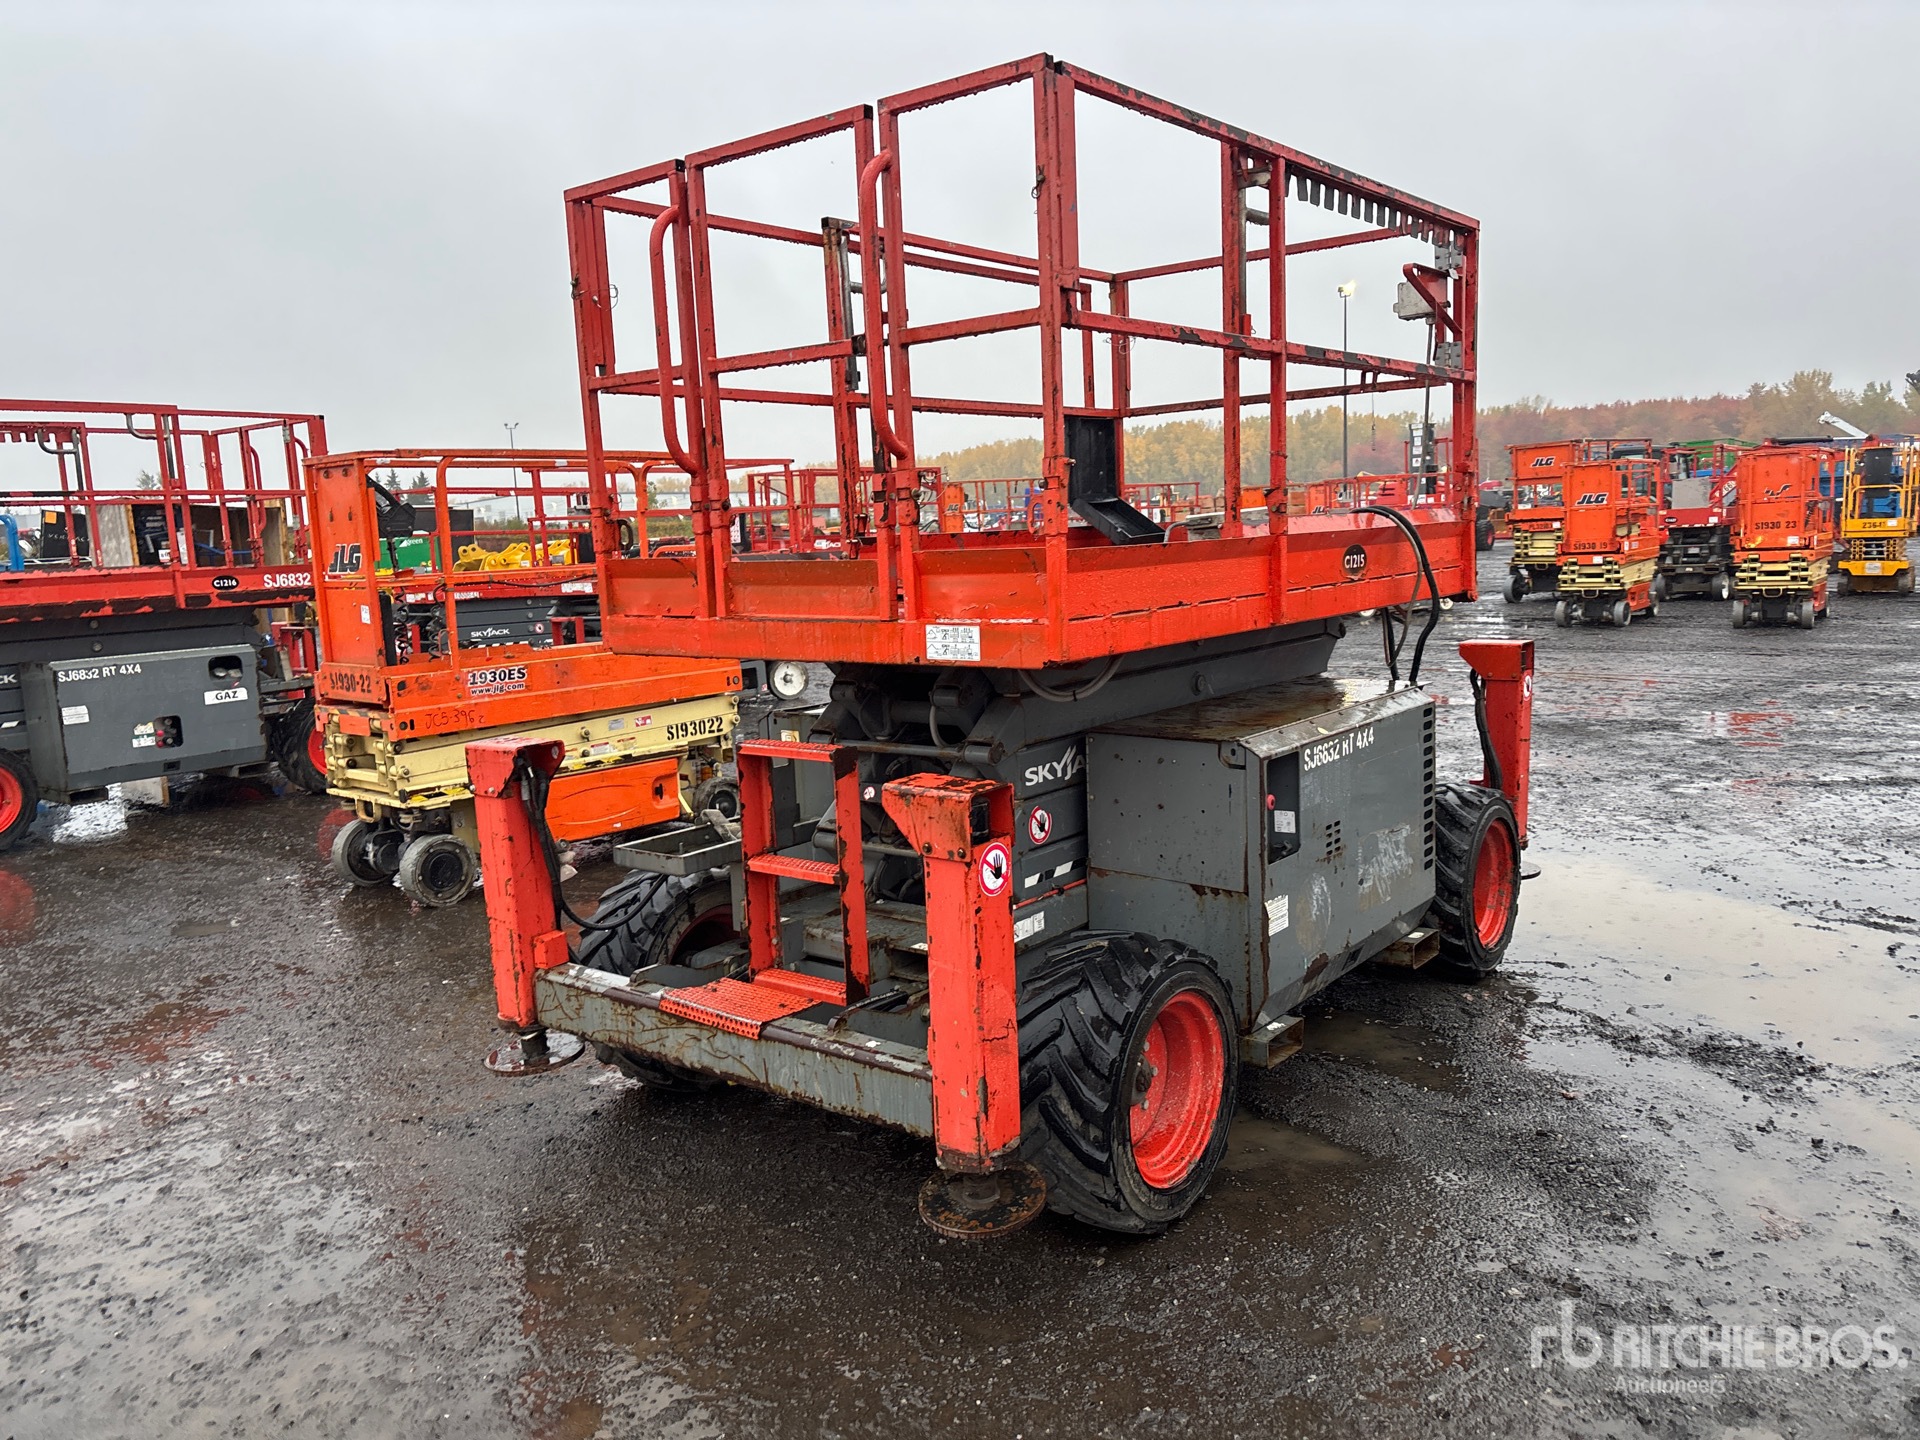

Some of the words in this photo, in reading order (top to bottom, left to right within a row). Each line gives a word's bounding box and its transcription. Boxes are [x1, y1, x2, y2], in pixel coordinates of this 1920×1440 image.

[1531, 456, 1555, 467] JLG
[1576, 492, 1609, 506] JLG
[1785, 520, 1797, 529] 23
[328, 543, 362, 574] JLG
[1344, 554, 1365, 569] C1215
[213, 579, 238, 587] C1216
[263, 573, 312, 588] SJ6832
[470, 627, 510, 638] SKYJACK
[57, 668, 99, 683] SJ6832
[102, 666, 117, 677] RT
[119, 663, 141, 675] 4X4
[468, 665, 527, 687] 1930ES
[215, 690, 239, 701] GAZ
[470, 682, 525, 695] www.jlg.com
[1356, 726, 1375, 750] 4X4
